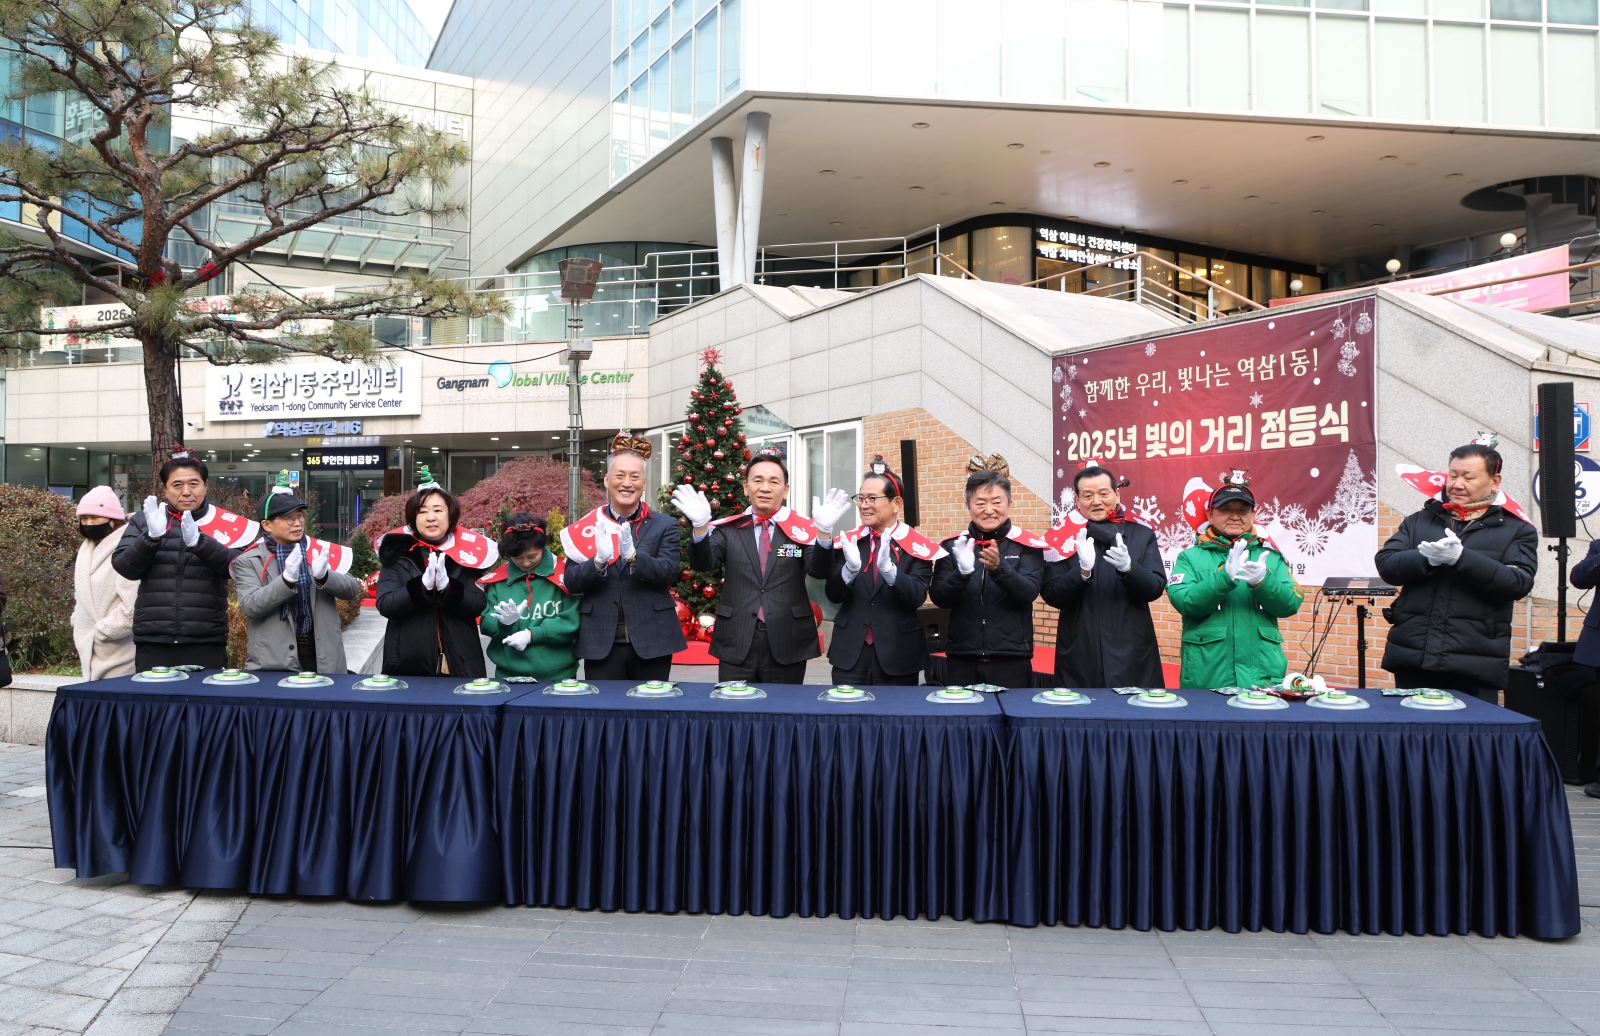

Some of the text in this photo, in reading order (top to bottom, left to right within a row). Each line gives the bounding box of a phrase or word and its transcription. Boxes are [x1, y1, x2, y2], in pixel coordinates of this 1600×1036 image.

[437, 377, 489, 392] Gangnam
[545, 371, 588, 386] Ville
[591, 371, 634, 384] Center
[1084, 347, 1318, 403] 함께한 우리, 빛나는 역삼1동!
[249, 367, 403, 399] 역삼1동주민센터
[560, 389, 587, 397] Ceer
[251, 398, 402, 412] Yeoksam 1-dong Community Service Center
[343, 420, 361, 434] 16
[1067, 400, 1349, 461] 2025년 빛의 거리 점등식
[307, 456, 320, 465] 365
[1296, 563, 1306, 574] 앞
